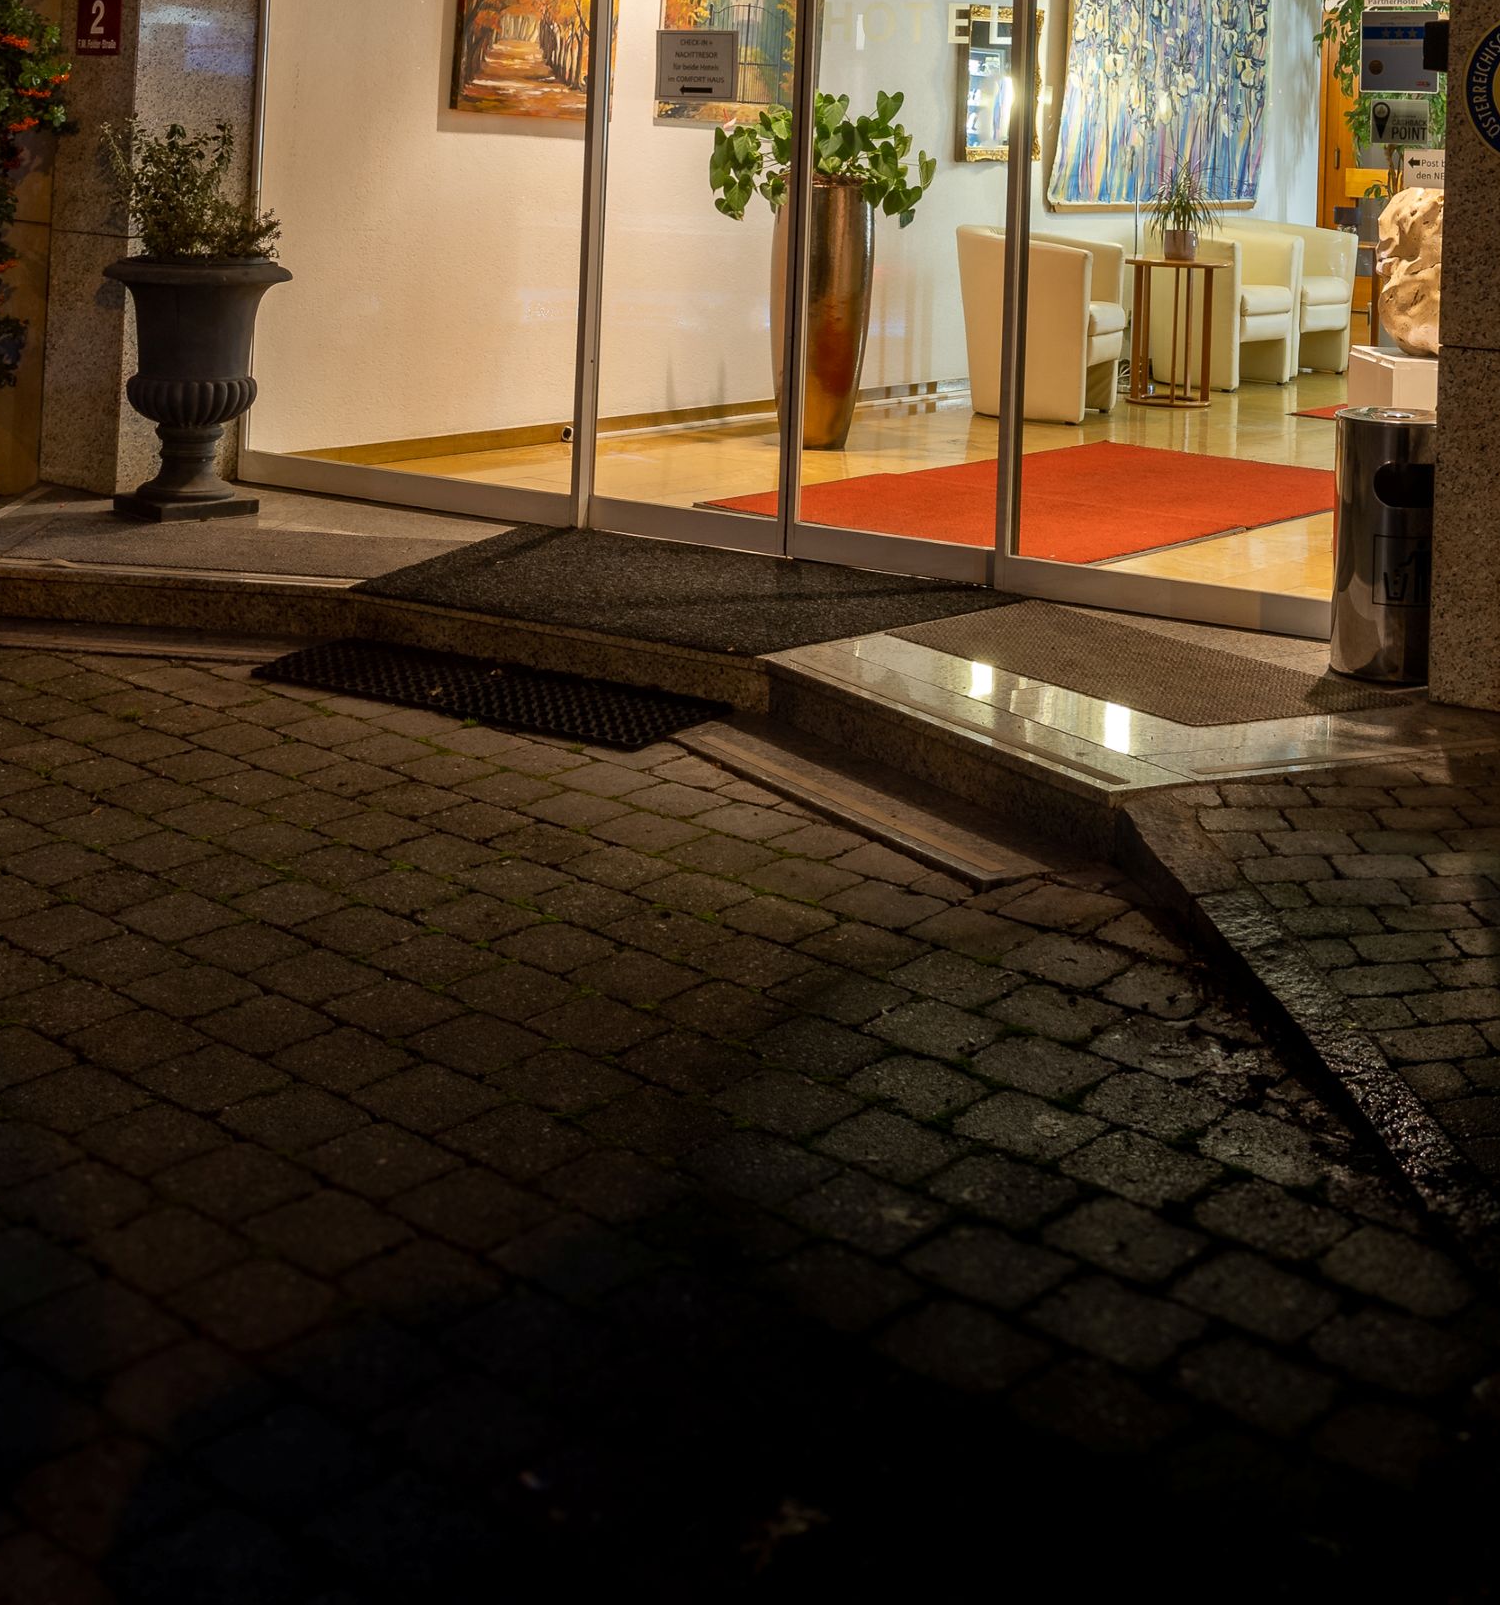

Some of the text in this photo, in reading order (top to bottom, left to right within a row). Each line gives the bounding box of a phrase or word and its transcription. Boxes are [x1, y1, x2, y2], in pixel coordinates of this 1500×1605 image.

[90, 0, 105, 34] 2
[1391, 127, 1428, 141] POINT
[1421, 159, 1439, 168] Post
[1416, 172, 1431, 180] den
